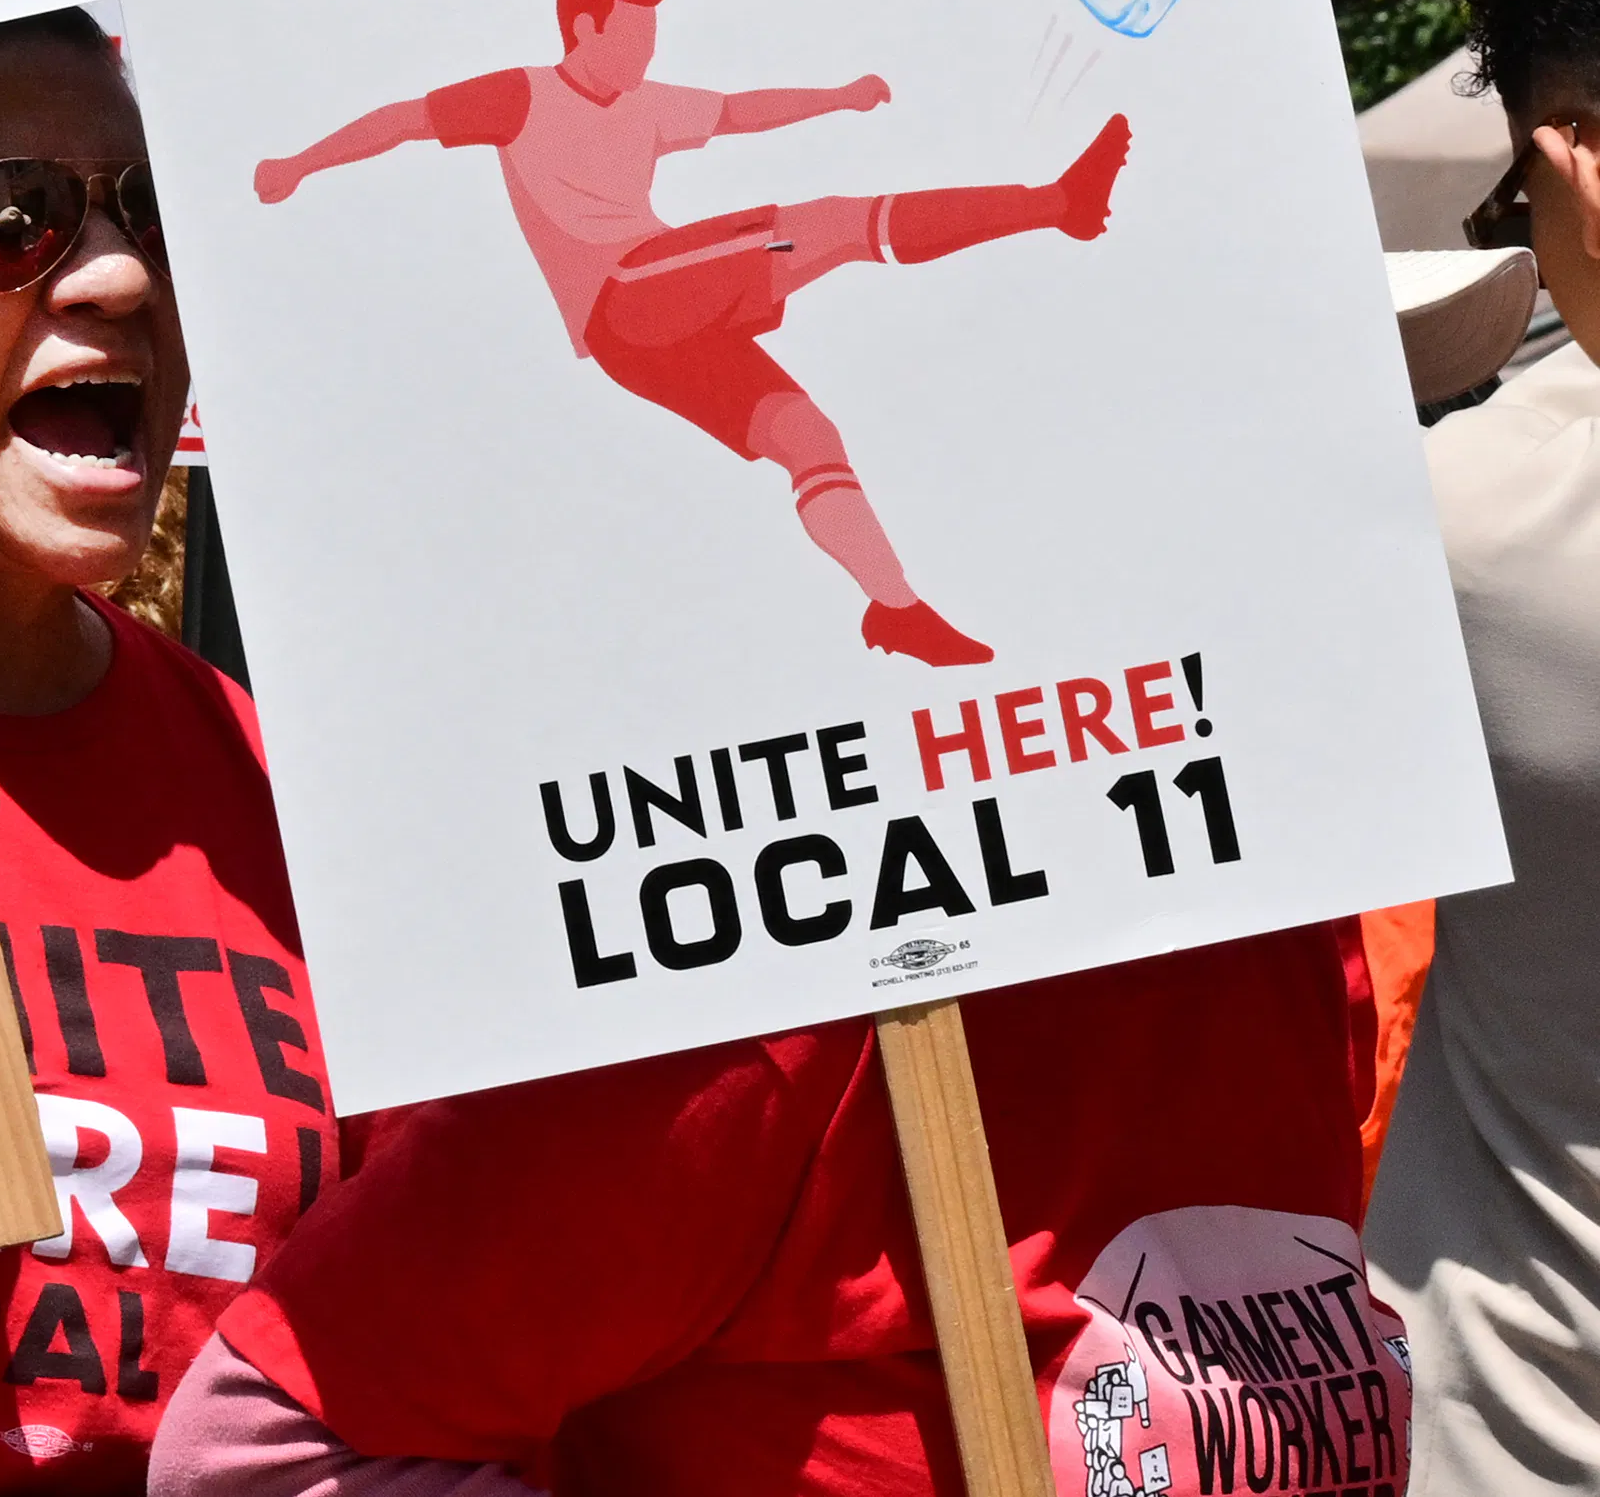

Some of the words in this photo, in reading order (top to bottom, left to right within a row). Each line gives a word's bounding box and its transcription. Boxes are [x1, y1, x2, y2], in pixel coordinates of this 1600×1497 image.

[540, 722, 878, 862] UNITE
[913, 653, 1213, 791] HERE!
[559, 798, 1048, 988] LOCAL
[1107, 757, 1241, 877] 11
[1134, 1272, 1377, 1385] GARMENT
[1181, 1370, 1397, 1496] WORKER
